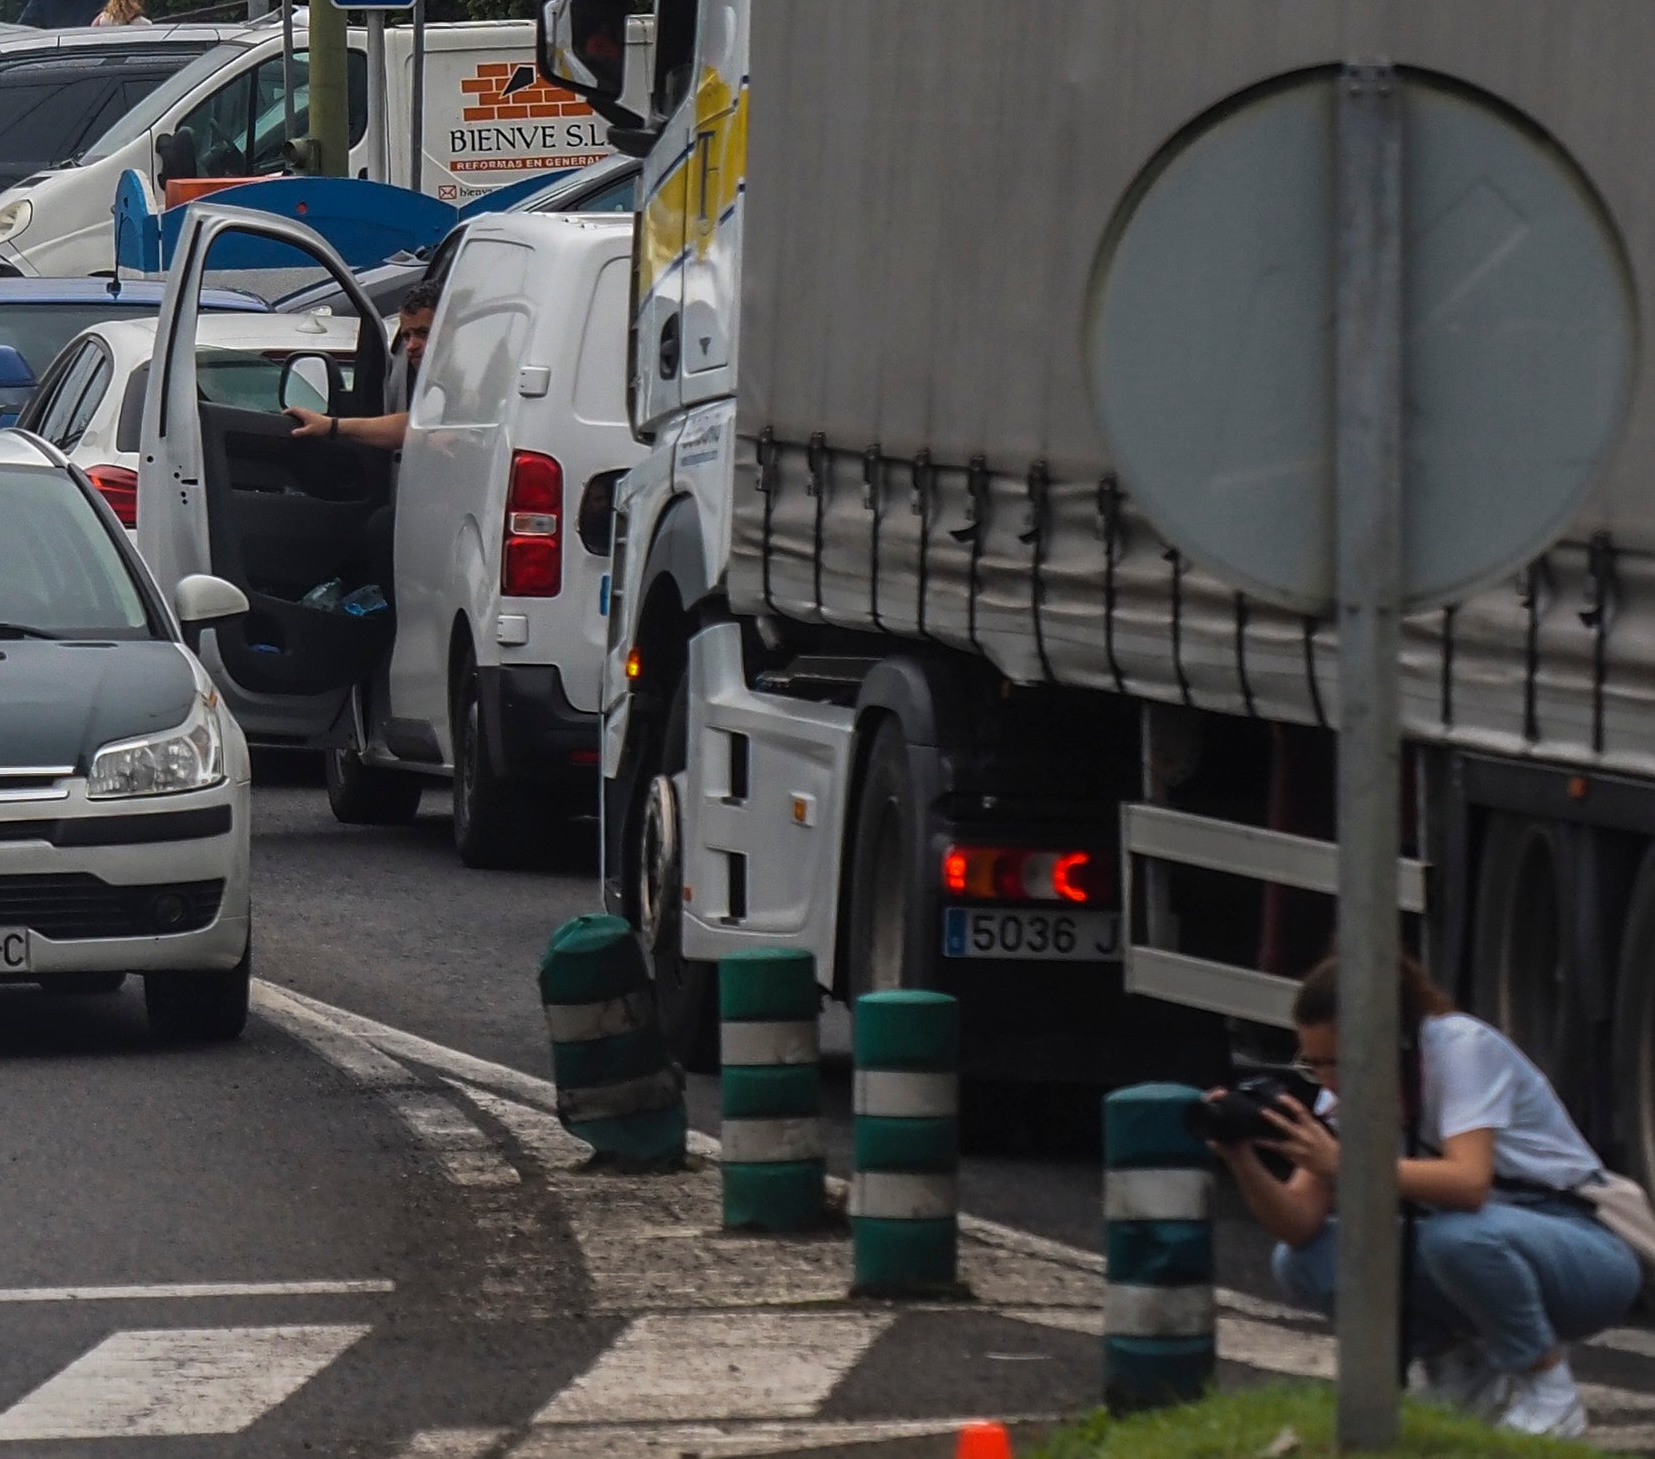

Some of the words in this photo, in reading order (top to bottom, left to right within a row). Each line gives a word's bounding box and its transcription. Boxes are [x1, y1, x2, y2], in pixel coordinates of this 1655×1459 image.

[450, 125, 556, 153] BIENVE
[456, 159, 523, 170] REFORMAS
[526, 158, 543, 168] EN
[972, 915, 1078, 954] 5036
